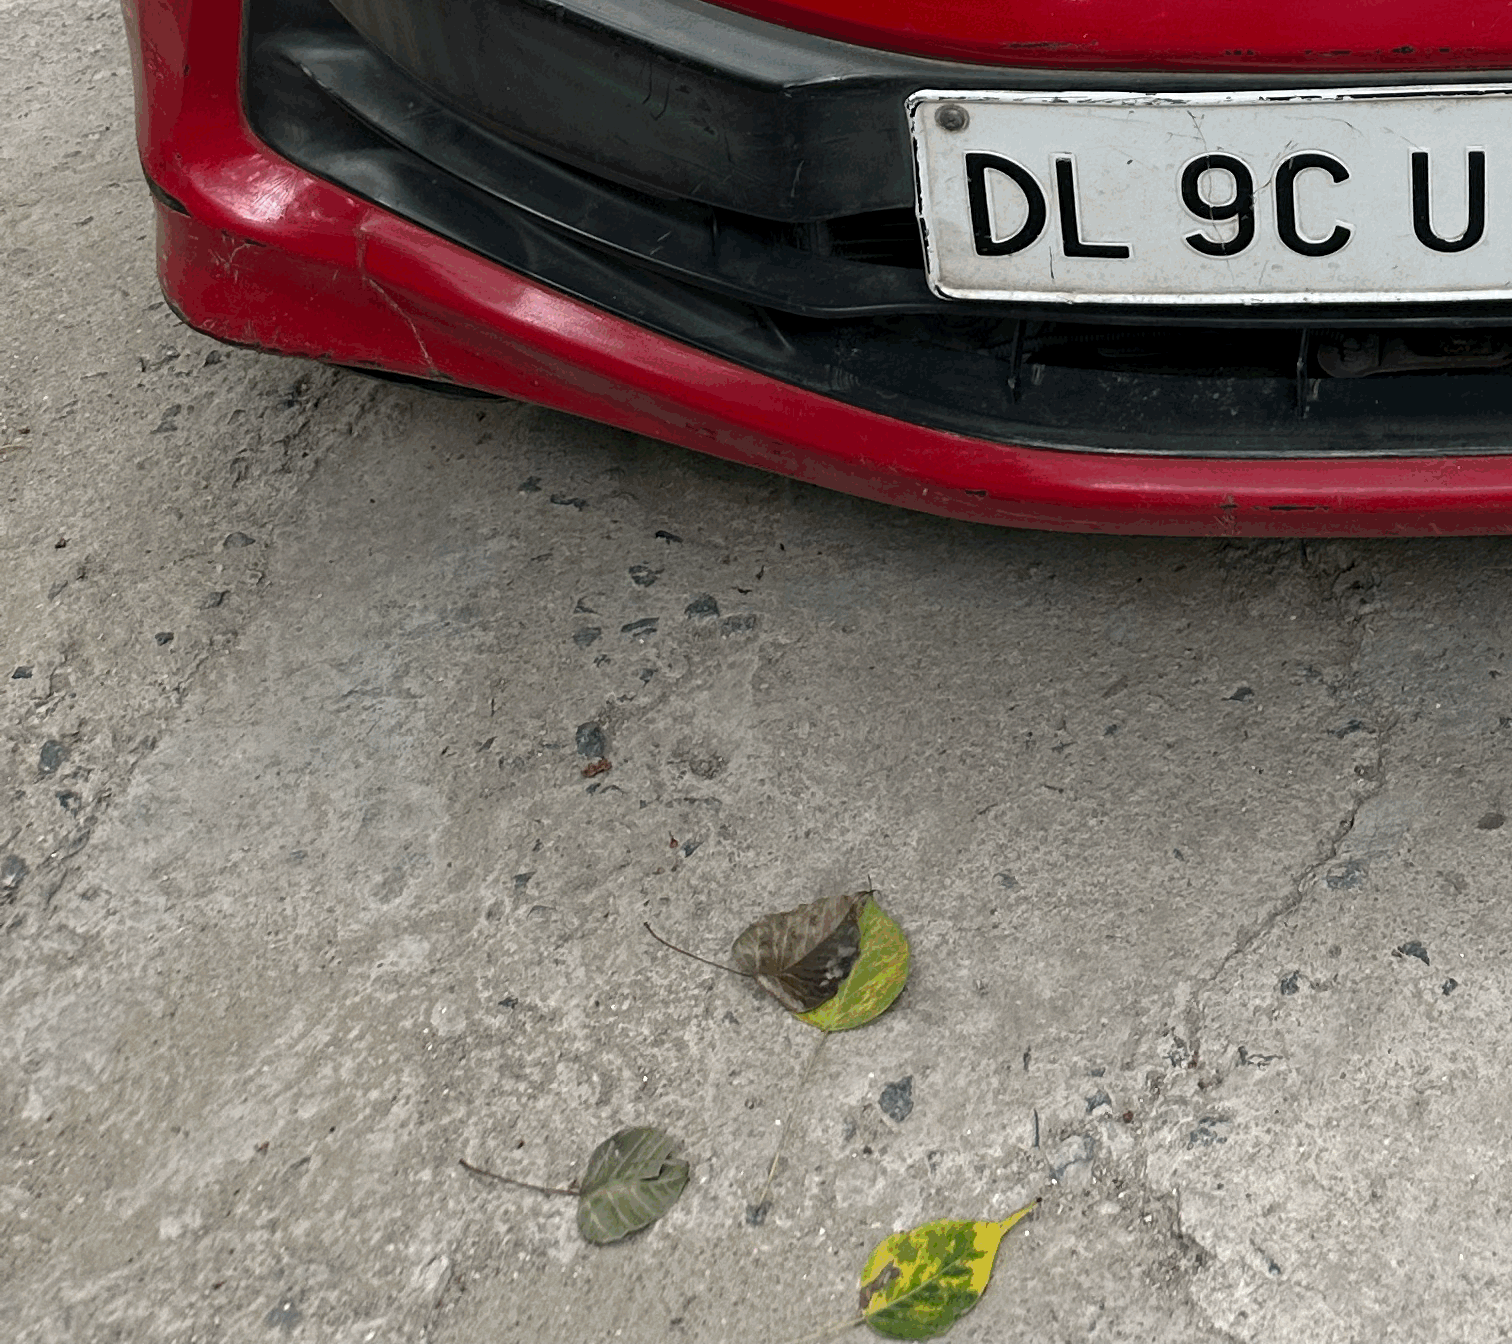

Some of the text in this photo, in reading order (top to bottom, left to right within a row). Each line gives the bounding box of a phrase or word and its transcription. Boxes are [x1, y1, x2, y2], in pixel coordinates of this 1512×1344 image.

[964, 151, 1131, 259] DL
[1181, 152, 1351, 258] 9C
[1411, 150, 1486, 253] U
